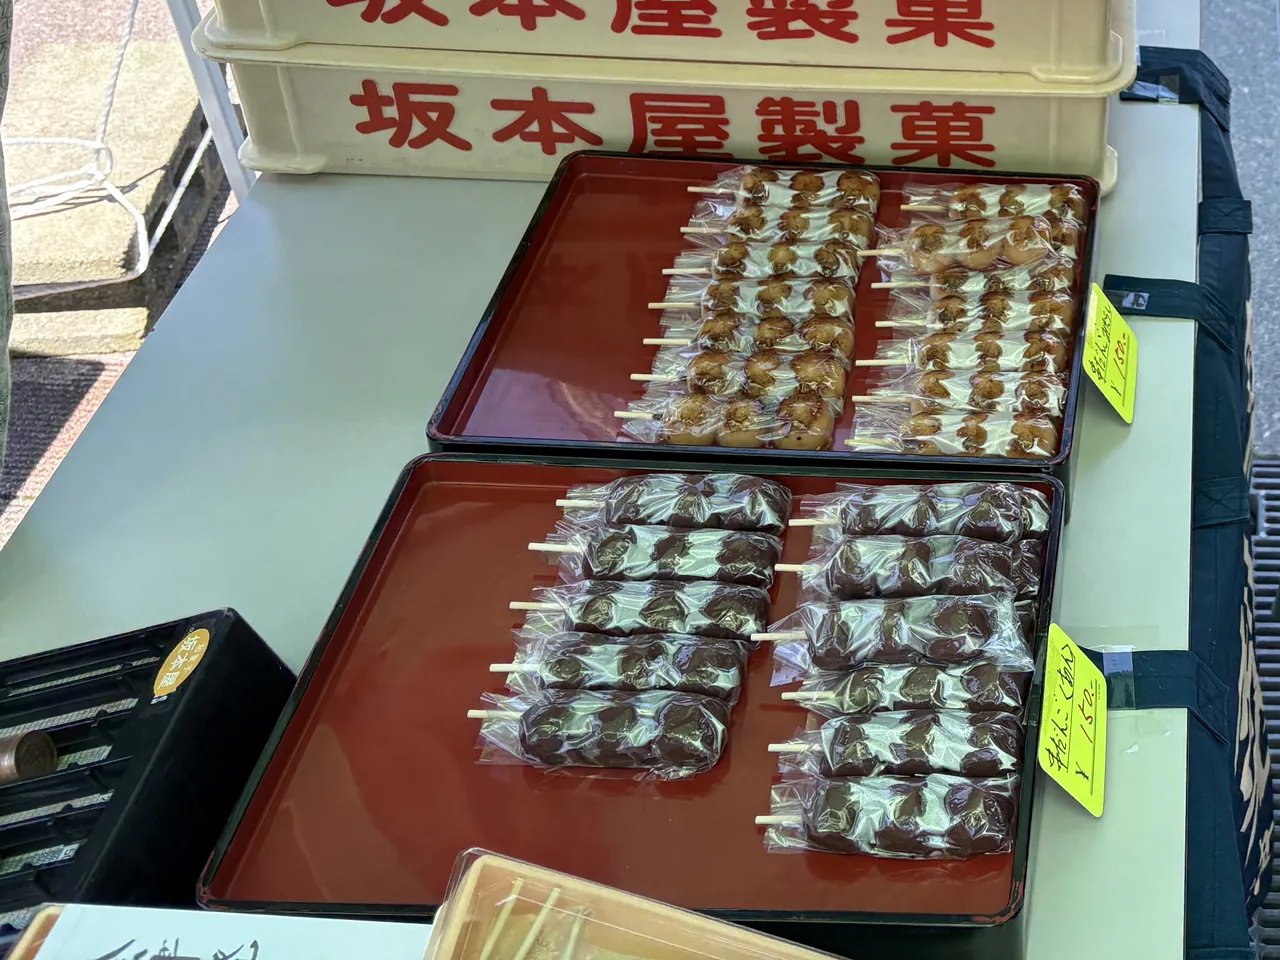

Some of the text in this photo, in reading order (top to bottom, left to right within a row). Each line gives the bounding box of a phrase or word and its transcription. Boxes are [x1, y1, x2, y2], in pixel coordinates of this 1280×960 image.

[349, 79, 996, 168] 坂本屋製菓
[157, 634, 201, 690] 坂本屋
